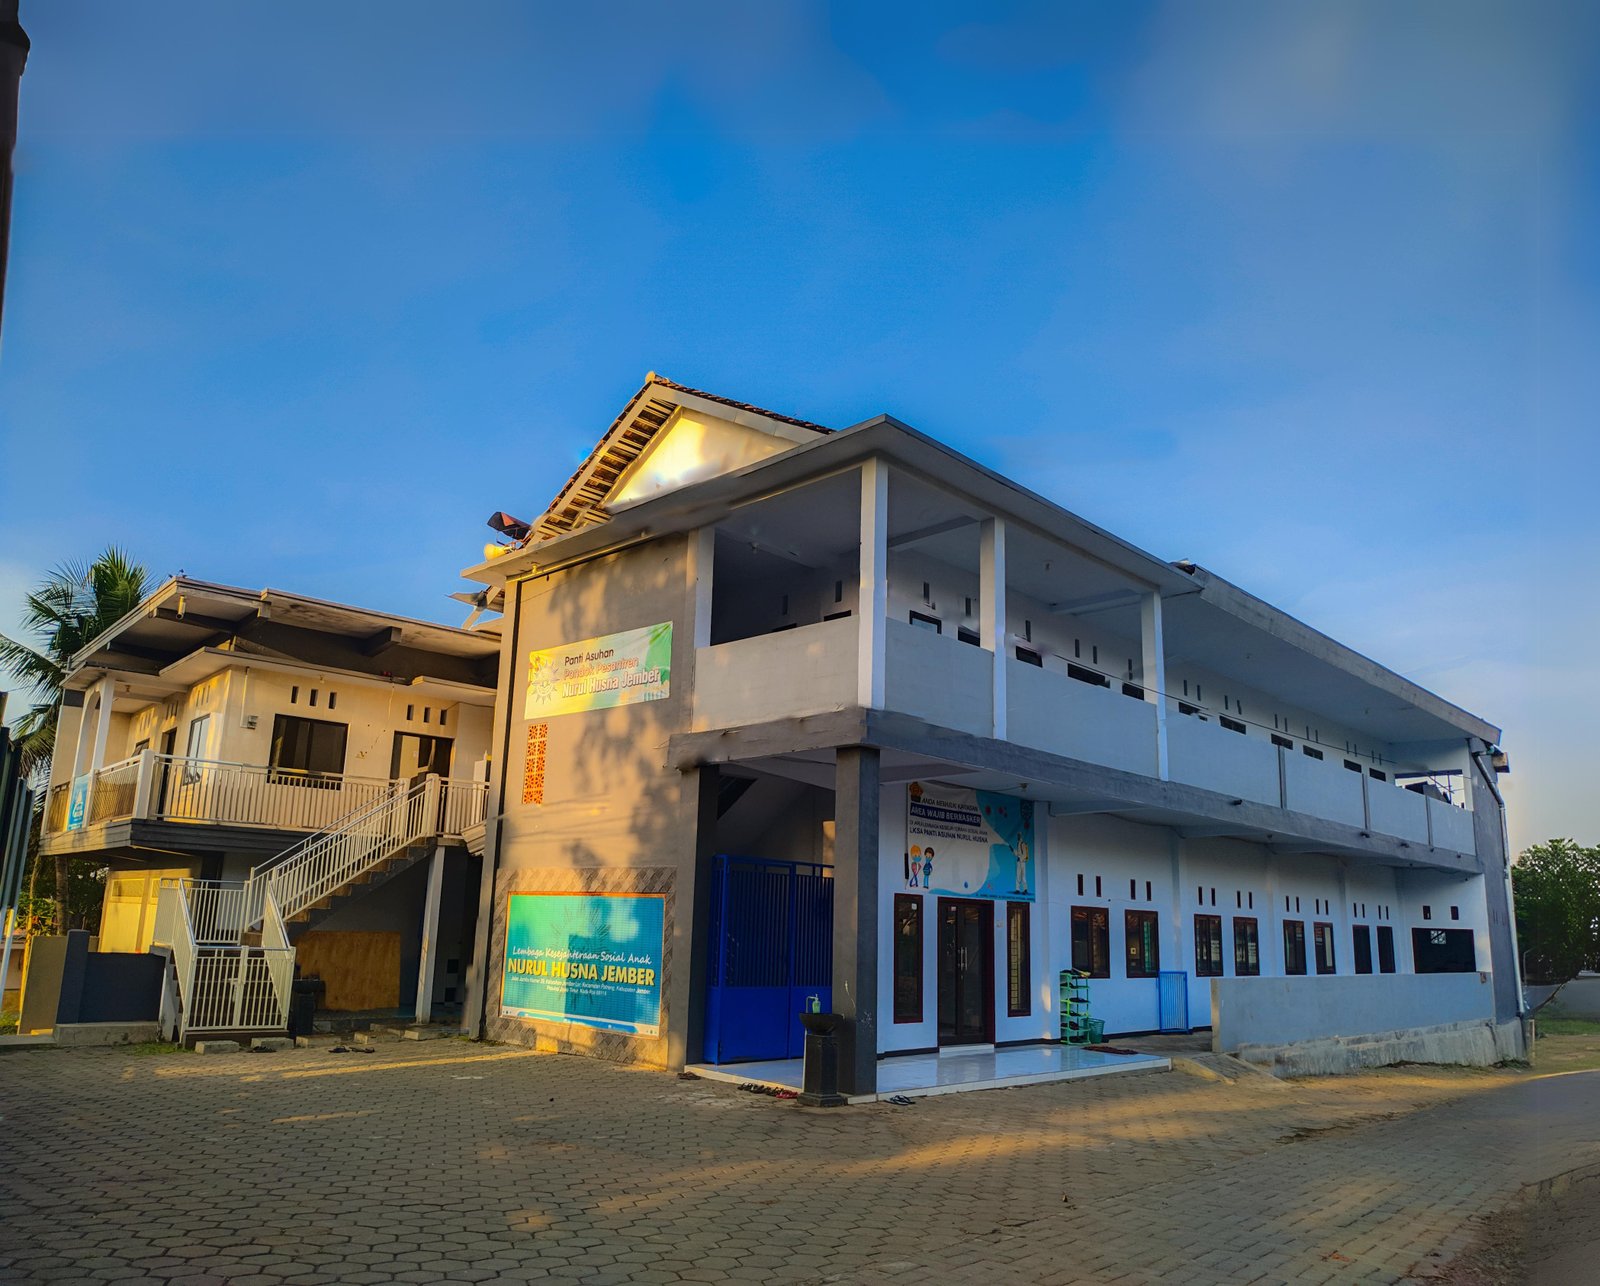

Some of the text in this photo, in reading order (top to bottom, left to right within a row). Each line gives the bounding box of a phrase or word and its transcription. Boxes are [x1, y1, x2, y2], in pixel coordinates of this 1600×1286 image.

[564, 648, 614, 666] Panti Asuhan
[564, 657, 640, 680] Pondok Pesantren
[562, 667, 660, 698] Nurul Husna Jember
[922, 797, 936, 806] ANDA
[910, 806, 926, 816] AREA
[926, 809, 945, 819] WAJIB
[923, 828, 938, 836] PANTI
[512, 945, 652, 965] Lembaga Kesejahteraan Sosial Anak
[507, 958, 548, 976] NURUL
[551, 961, 598, 980] HUSNA
[601, 964, 656, 986] JEMBER
